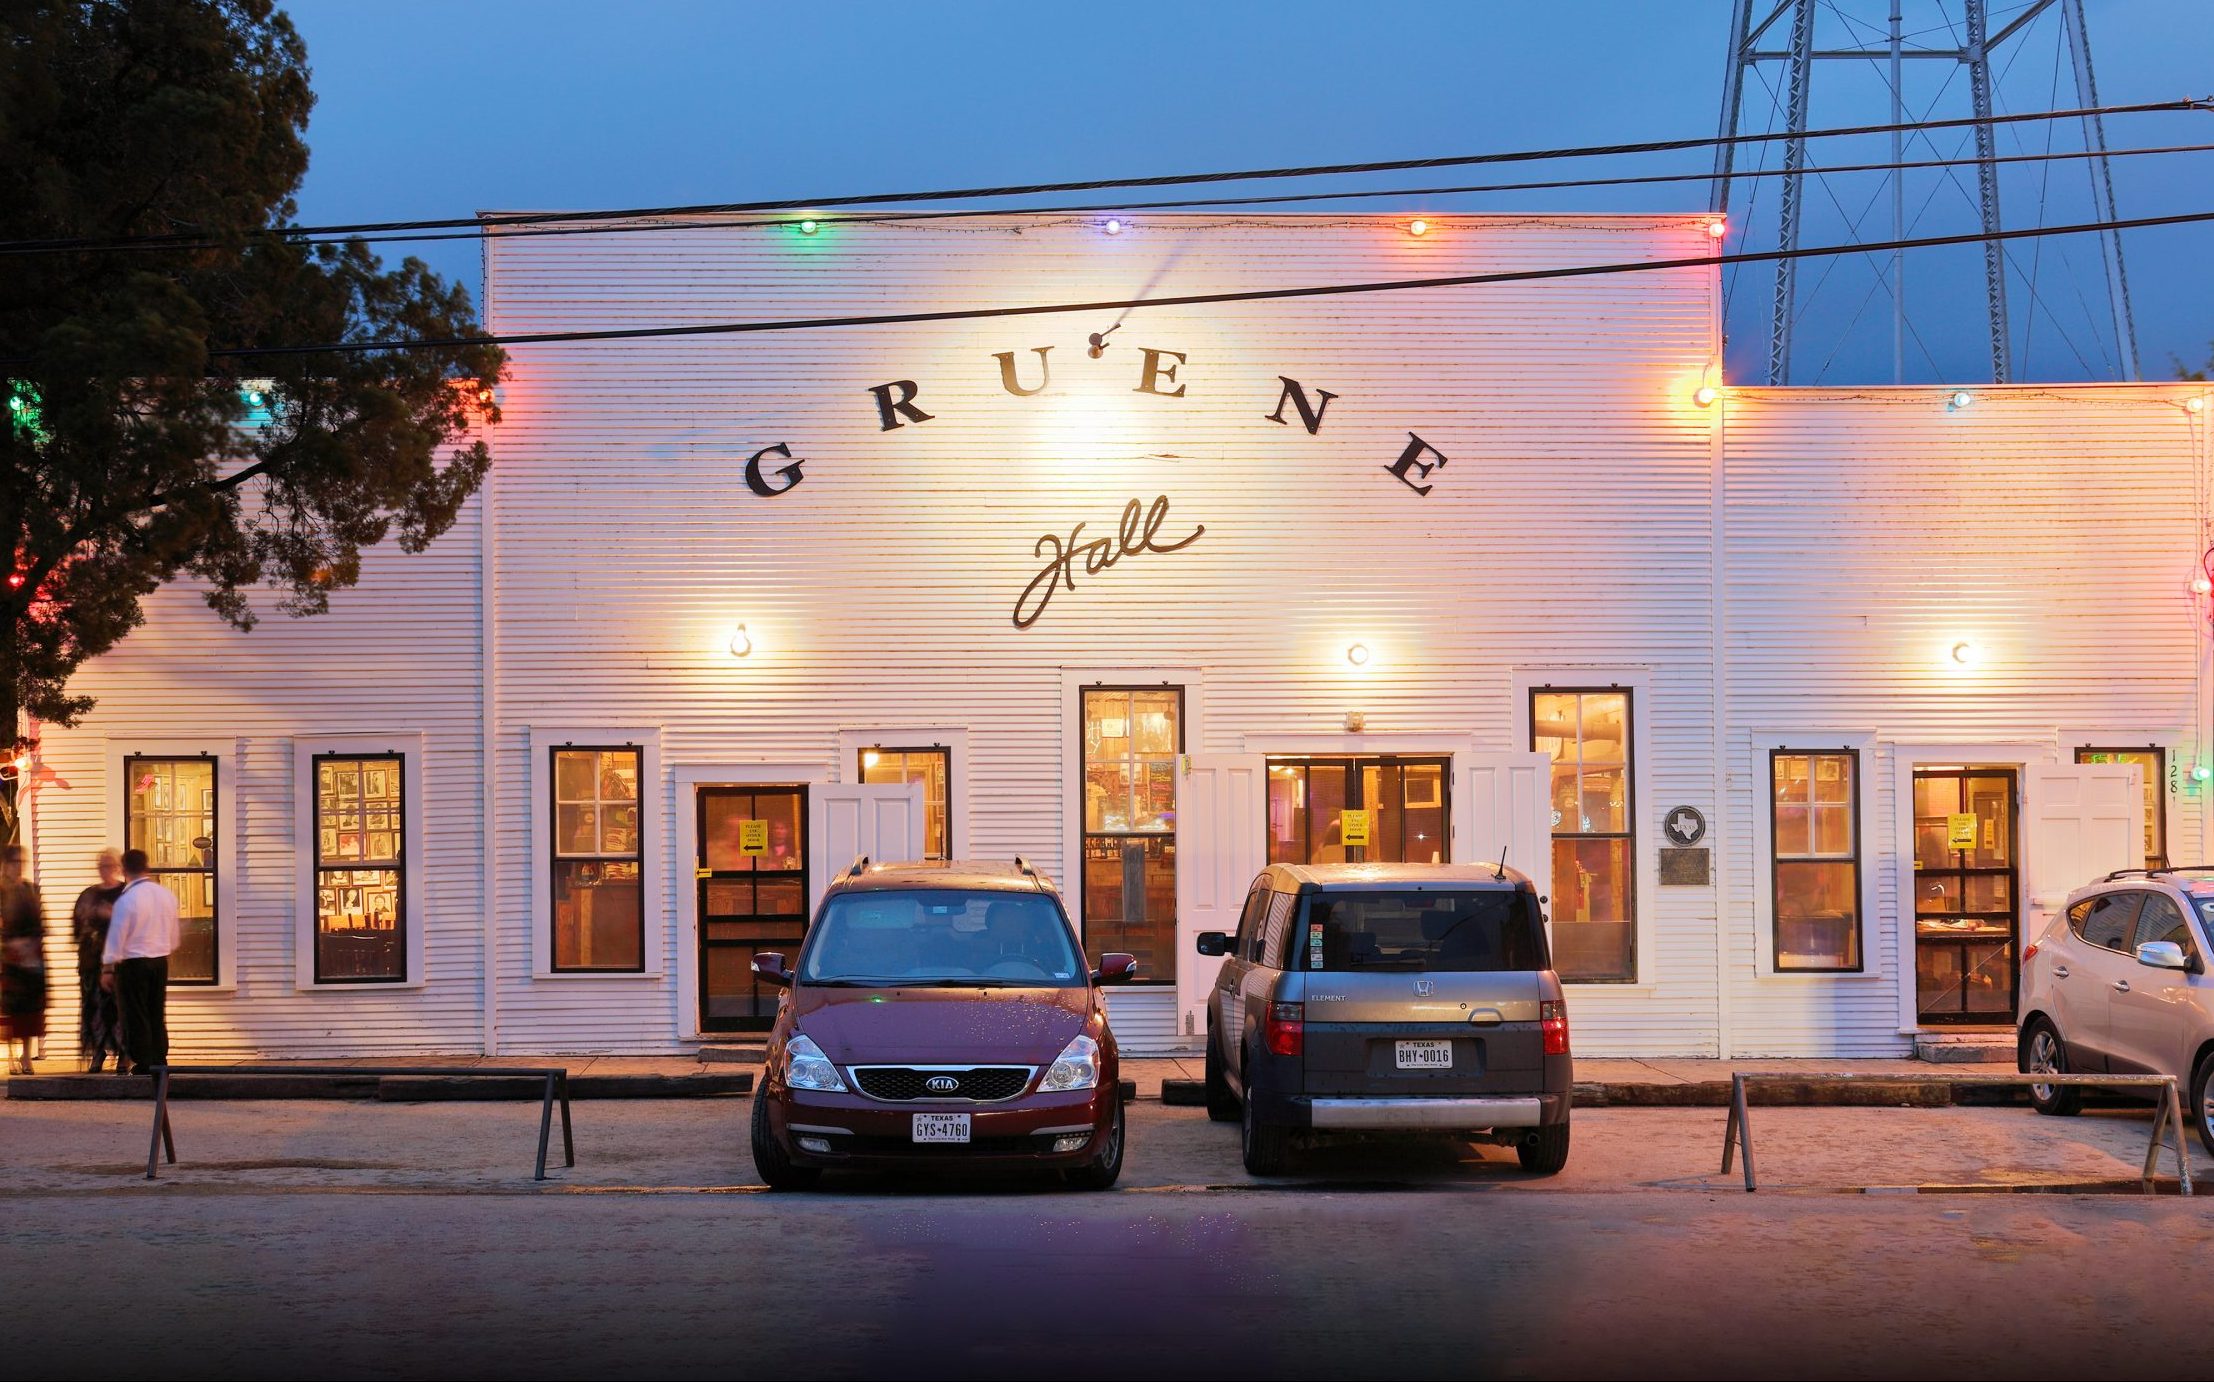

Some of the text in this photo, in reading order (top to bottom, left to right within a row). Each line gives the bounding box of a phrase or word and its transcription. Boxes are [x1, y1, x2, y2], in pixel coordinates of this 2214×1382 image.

[744, 345, 1449, 498] GRUENE
[1012, 494, 1205, 629] Hall
[1311, 994, 1346, 1002] ELEMENT
[931, 1079, 954, 1089] KIA
